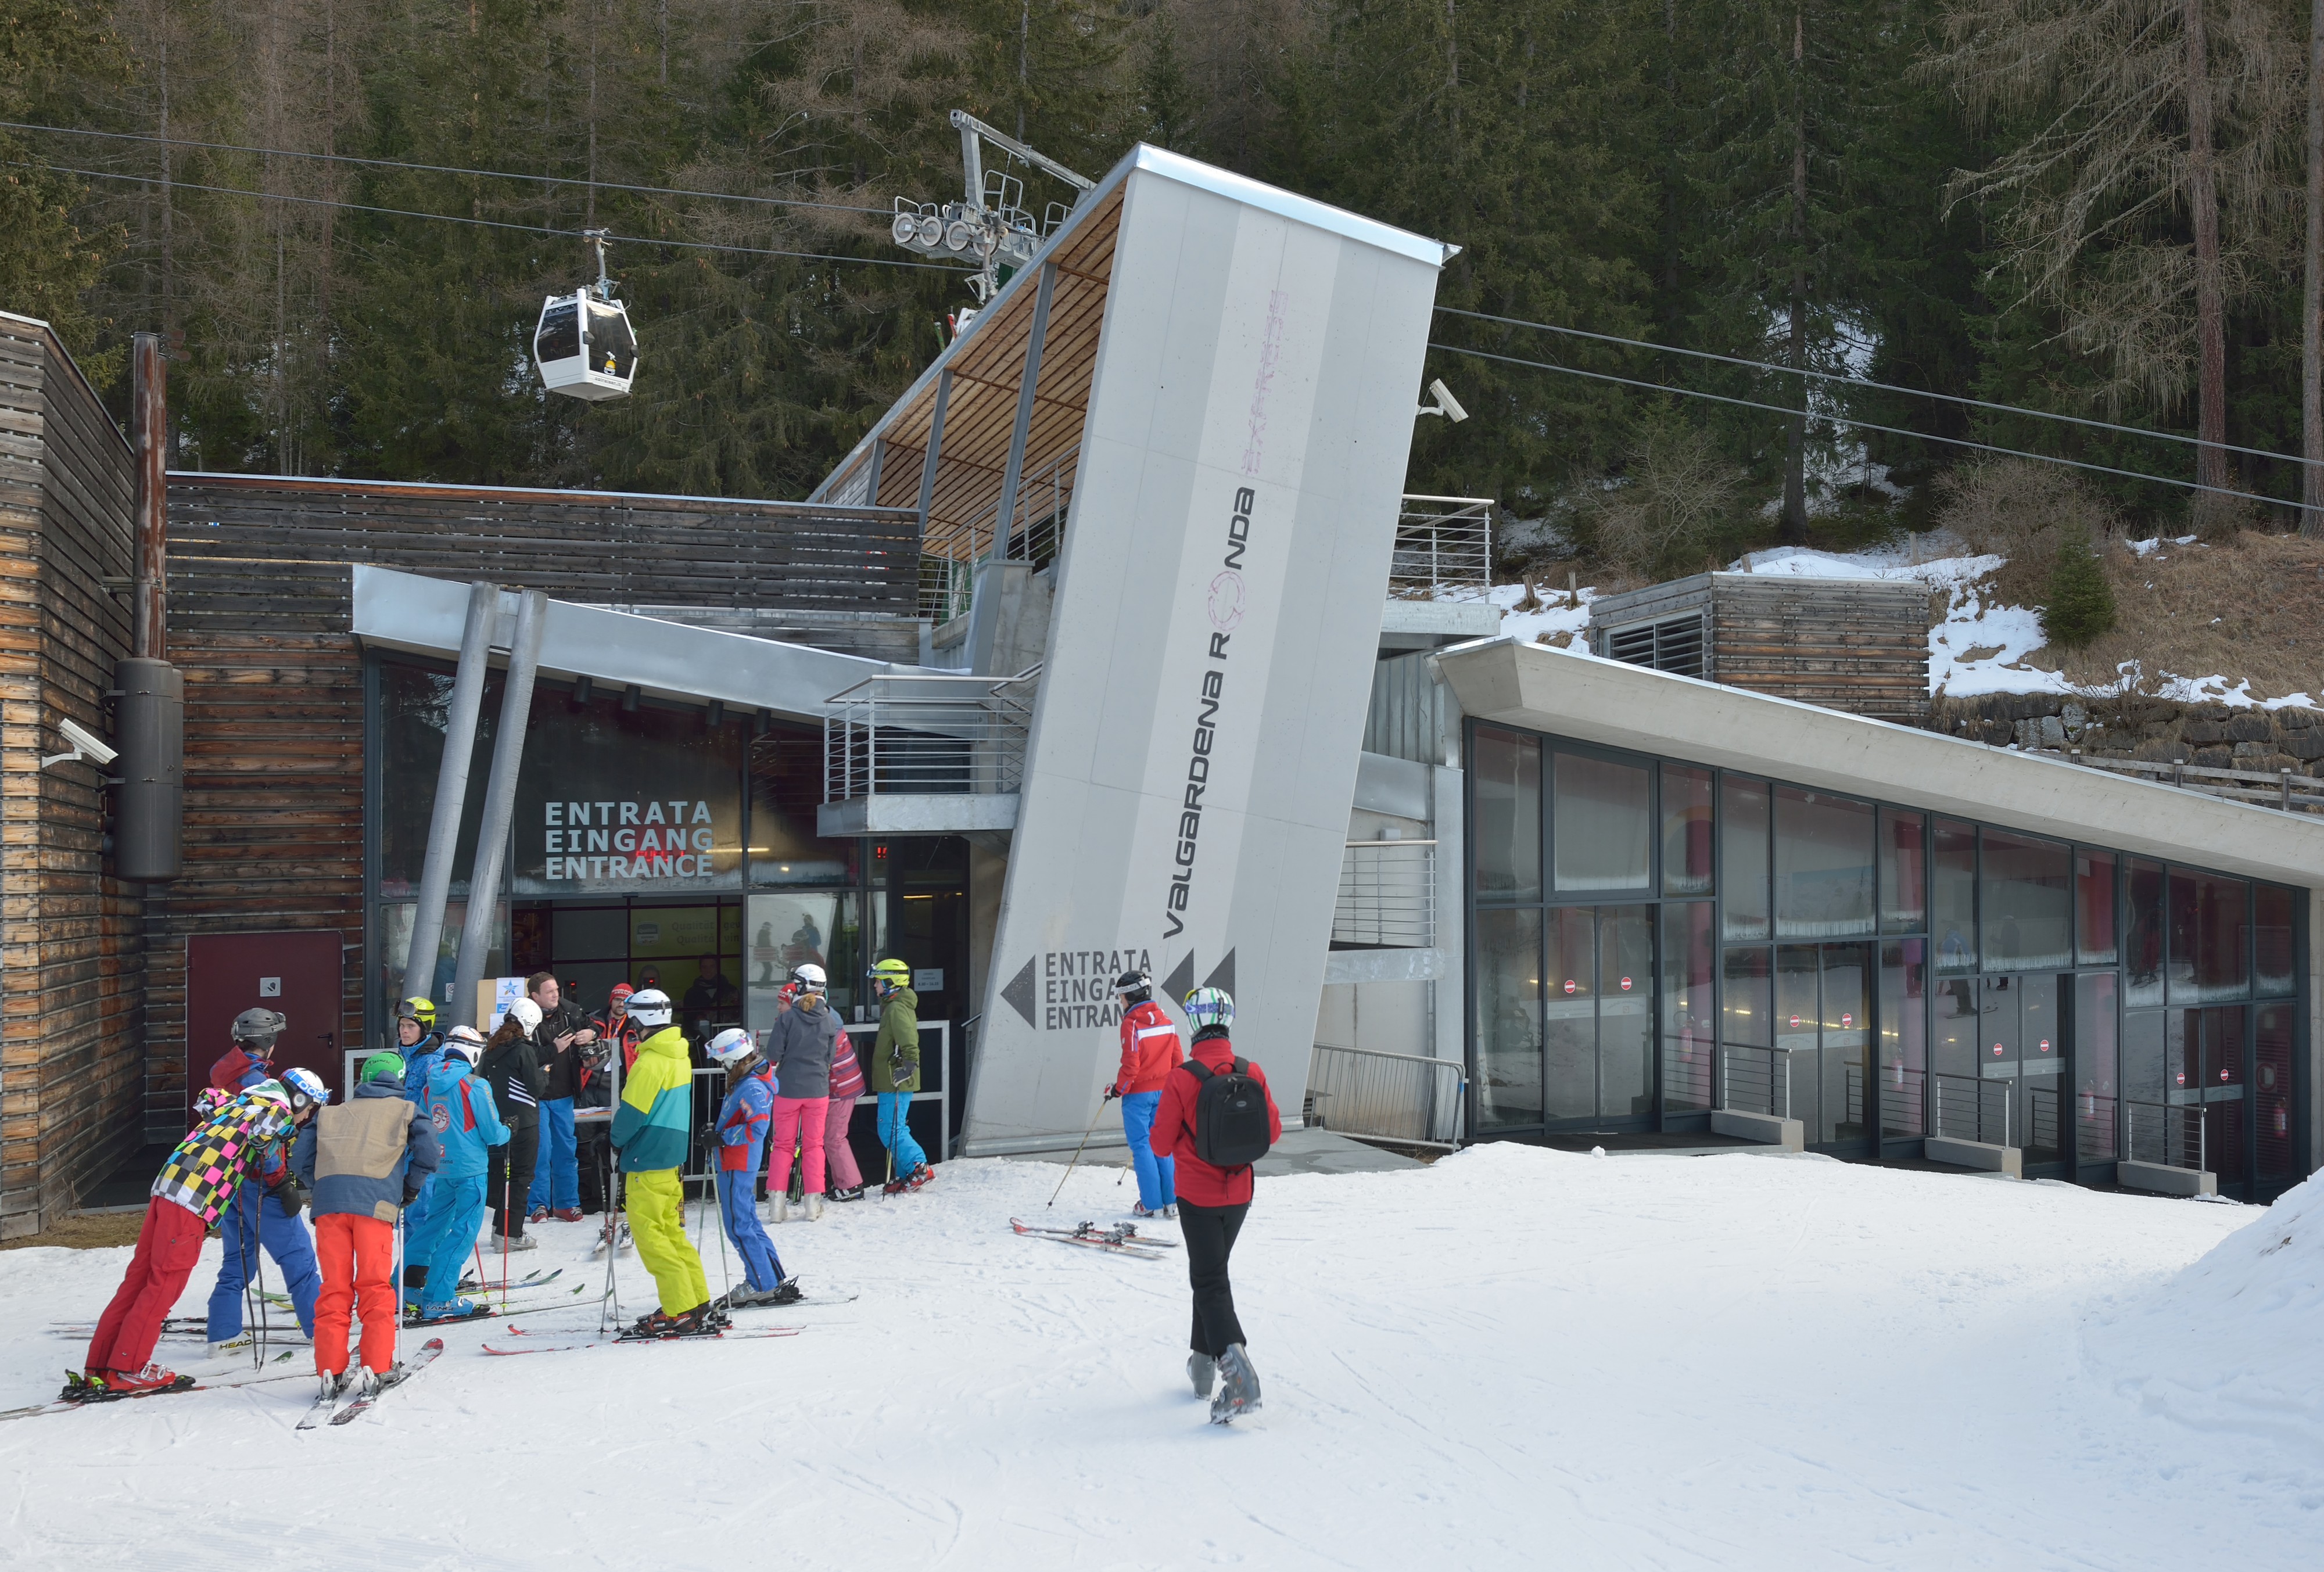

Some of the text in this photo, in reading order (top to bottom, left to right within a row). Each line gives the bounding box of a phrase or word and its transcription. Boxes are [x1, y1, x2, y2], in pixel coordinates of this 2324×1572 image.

[546, 801, 712, 826] ENTRATA
[546, 828, 713, 852] EINGANG
[546, 855, 713, 880] ENTRANCE
[1046, 949, 1152, 977] ENTRATA
[1046, 975, 1152, 1003] EINGA
[1046, 1003, 1125, 1030] ENTRAN
[218, 1339, 253, 1351] HEAD
